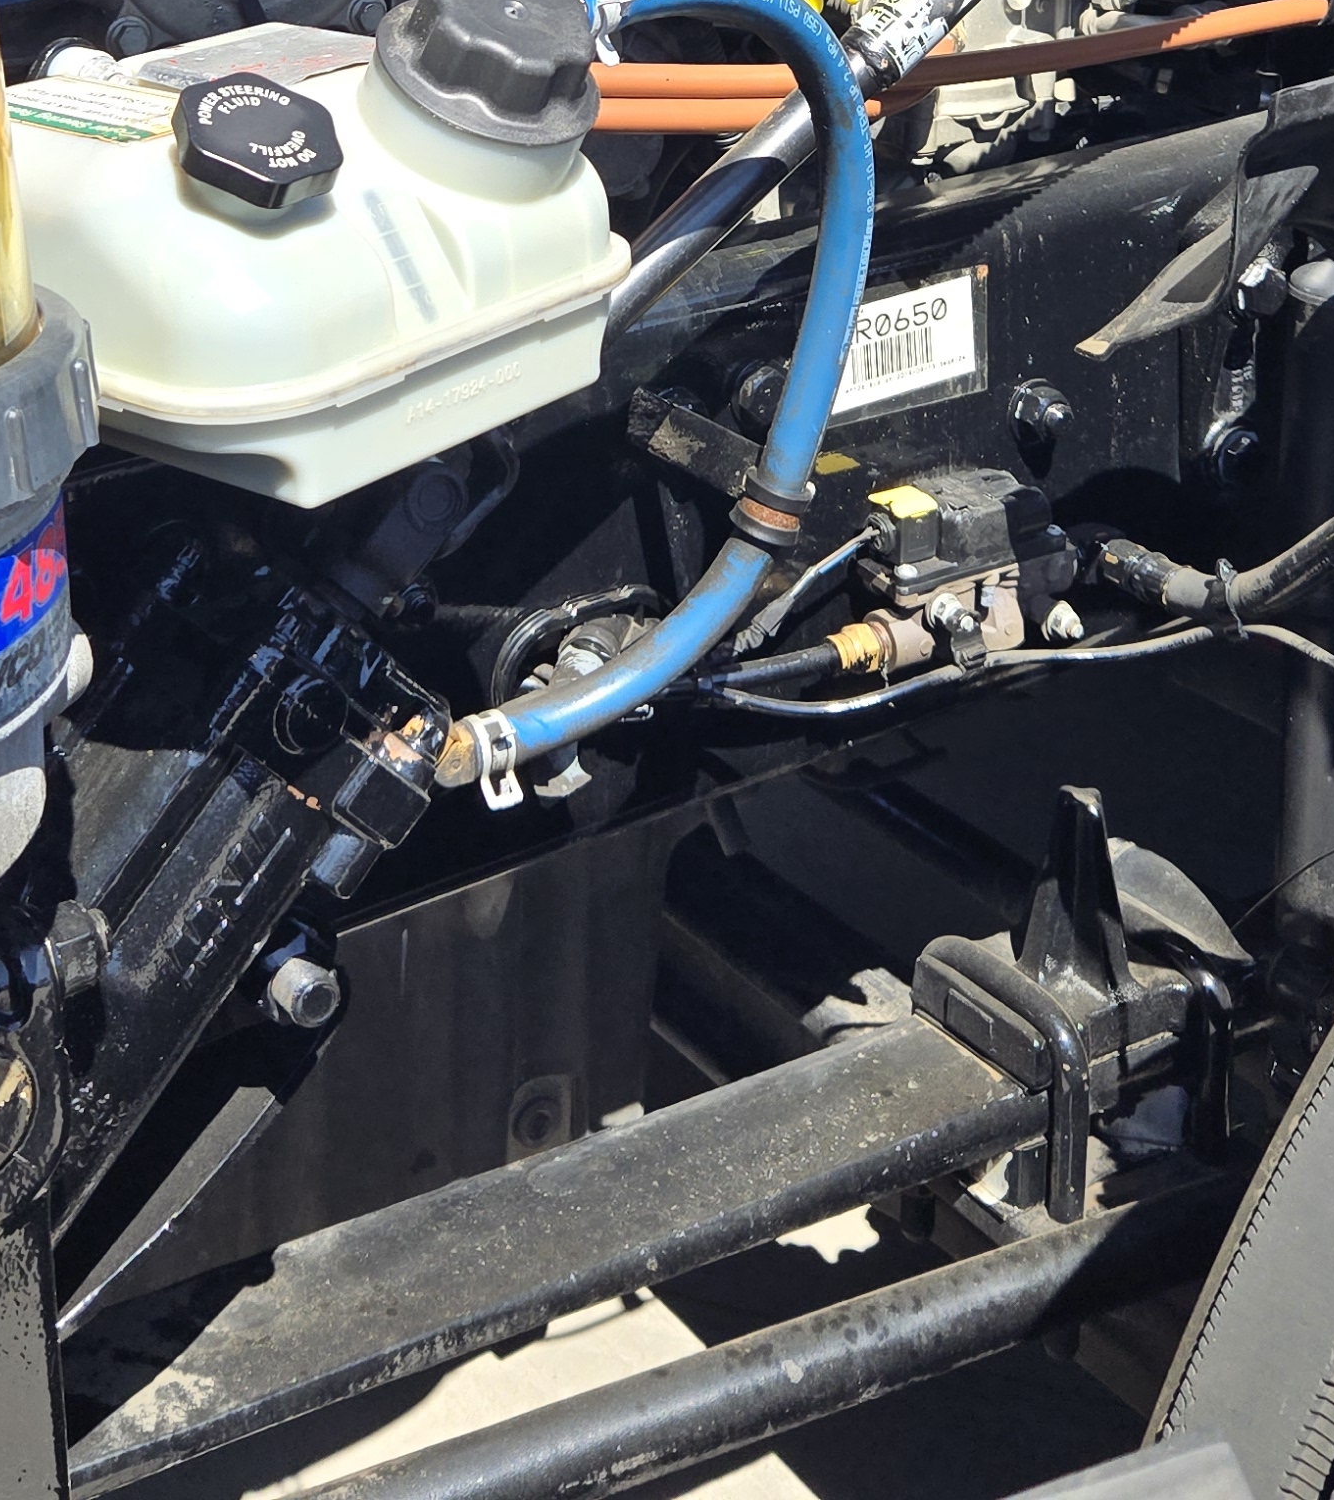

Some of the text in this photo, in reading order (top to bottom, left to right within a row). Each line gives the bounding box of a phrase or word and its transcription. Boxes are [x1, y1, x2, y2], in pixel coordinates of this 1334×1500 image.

[802, 14, 823, 38] (350
[838, 57, 853, 82] 2.4
[198, 93, 223, 125] POWER
[219, 84, 290, 107] STEERING
[217, 96, 261, 115] FLUID
[248, 130, 306, 157] OVERFILL
[855, 104, 876, 159] HI-TEMP
[268, 149, 316, 169] DO NOT
[855, 297, 947, 344] R0650
